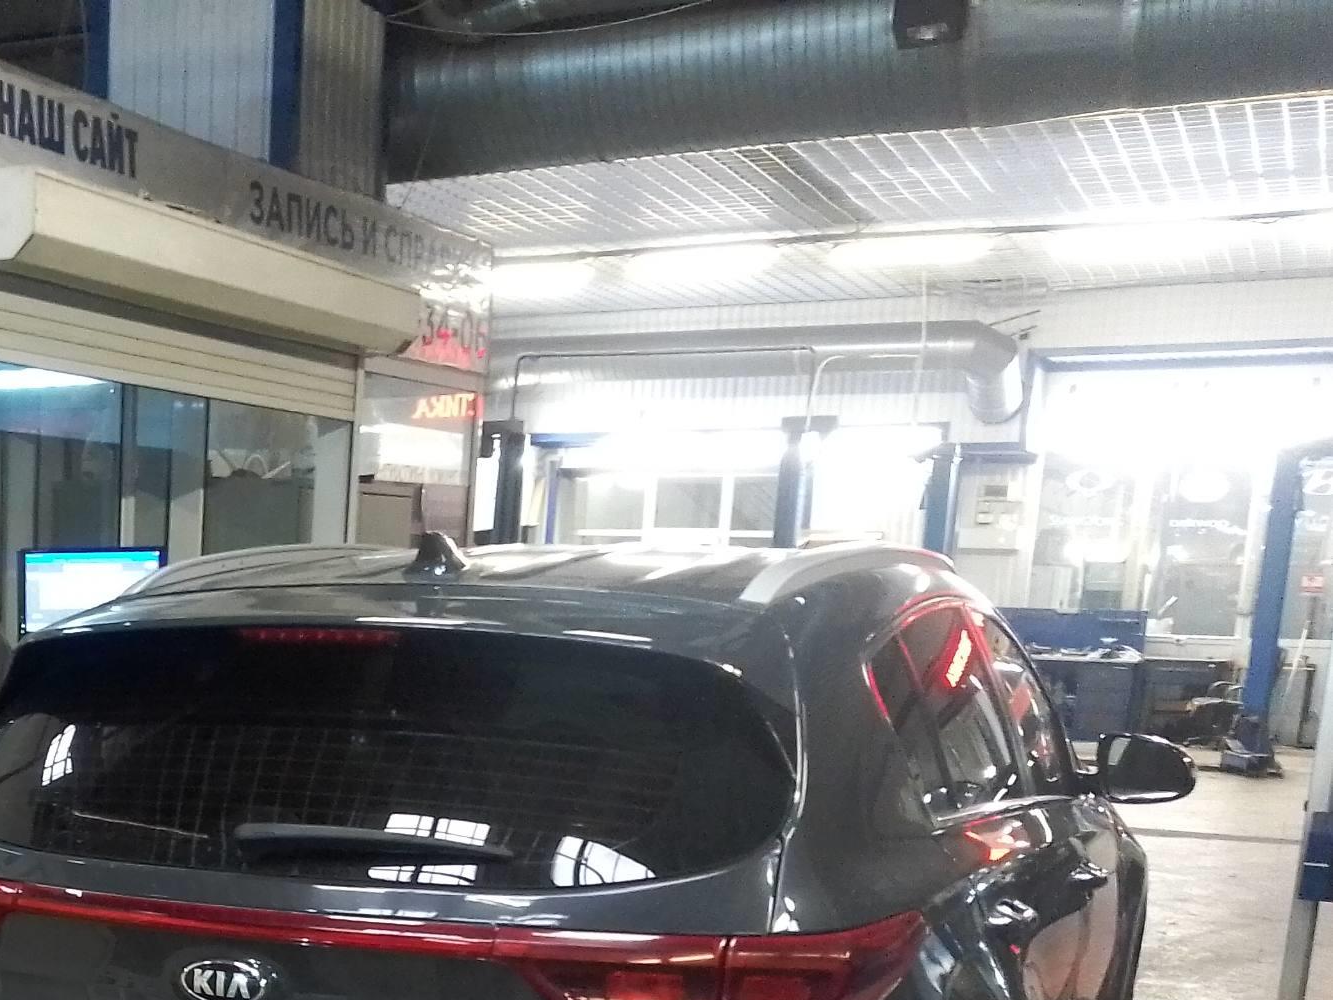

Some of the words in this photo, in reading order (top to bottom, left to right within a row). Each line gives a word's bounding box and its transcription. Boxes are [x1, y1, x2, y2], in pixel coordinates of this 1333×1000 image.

[71, 108, 139, 178] САЙТ
[249, 179, 355, 250] ЗАПИСЬ
[362, 215, 377, 258] И
[192, 967, 252, 1000] KIA
